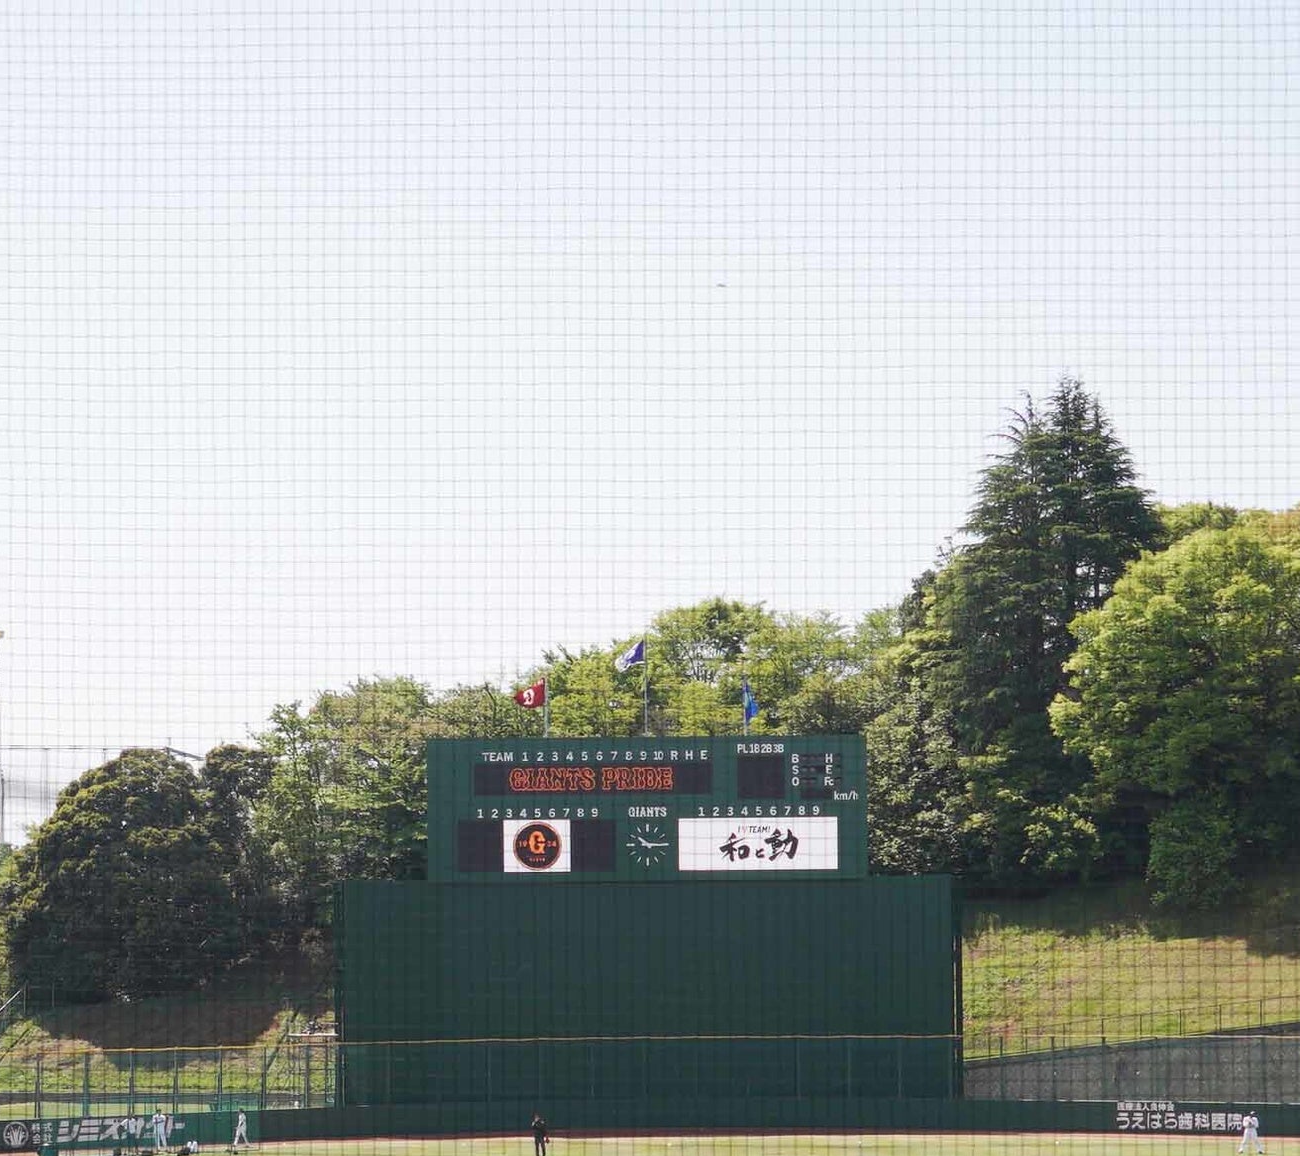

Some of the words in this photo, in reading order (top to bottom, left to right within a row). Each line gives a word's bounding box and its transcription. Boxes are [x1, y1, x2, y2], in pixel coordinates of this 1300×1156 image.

[481, 751, 514, 762] TEAM
[521, 751, 529, 762] 1
[536, 751, 544, 762] 2
[551, 751, 559, 762] 3
[565, 751, 574, 762] 4
[581, 751, 589, 762] 5
[596, 751, 604, 761] 6
[610, 751, 618, 761] 7
[625, 751, 633, 761] 8
[639, 751, 647, 761] 9
[652, 751, 664, 761] 10
[670, 750, 679, 761] R
[684, 749, 694, 760] H
[700, 749, 708, 760] E
[791, 765, 800, 775] S
[509, 767, 596, 792] GIANTS
[601, 766, 674, 791] PRIDE
[833, 790, 860, 803] km/h
[476, 808, 484, 819] 1
[491, 808, 500, 819] 2
[505, 808, 514, 819] 3
[519, 808, 528, 819] 4
[534, 808, 542, 819] 5
[548, 808, 557, 819] 6
[562, 808, 571, 819] 7
[576, 808, 585, 819] 8
[591, 808, 599, 819] 9
[627, 806, 668, 818] GIANTS
[698, 806, 706, 817] 1
[712, 806, 720, 817] 2
[726, 806, 734, 817] 3
[740, 806, 749, 817] 4
[755, 806, 763, 816] 5
[769, 806, 778, 816] 6
[784, 806, 792, 816] 7
[798, 806, 806, 816] 8
[812, 806, 820, 816] 9
[719, 828, 800, 863] 和と動
[1116, 1112, 1243, 1131] うえはら歯科医院
